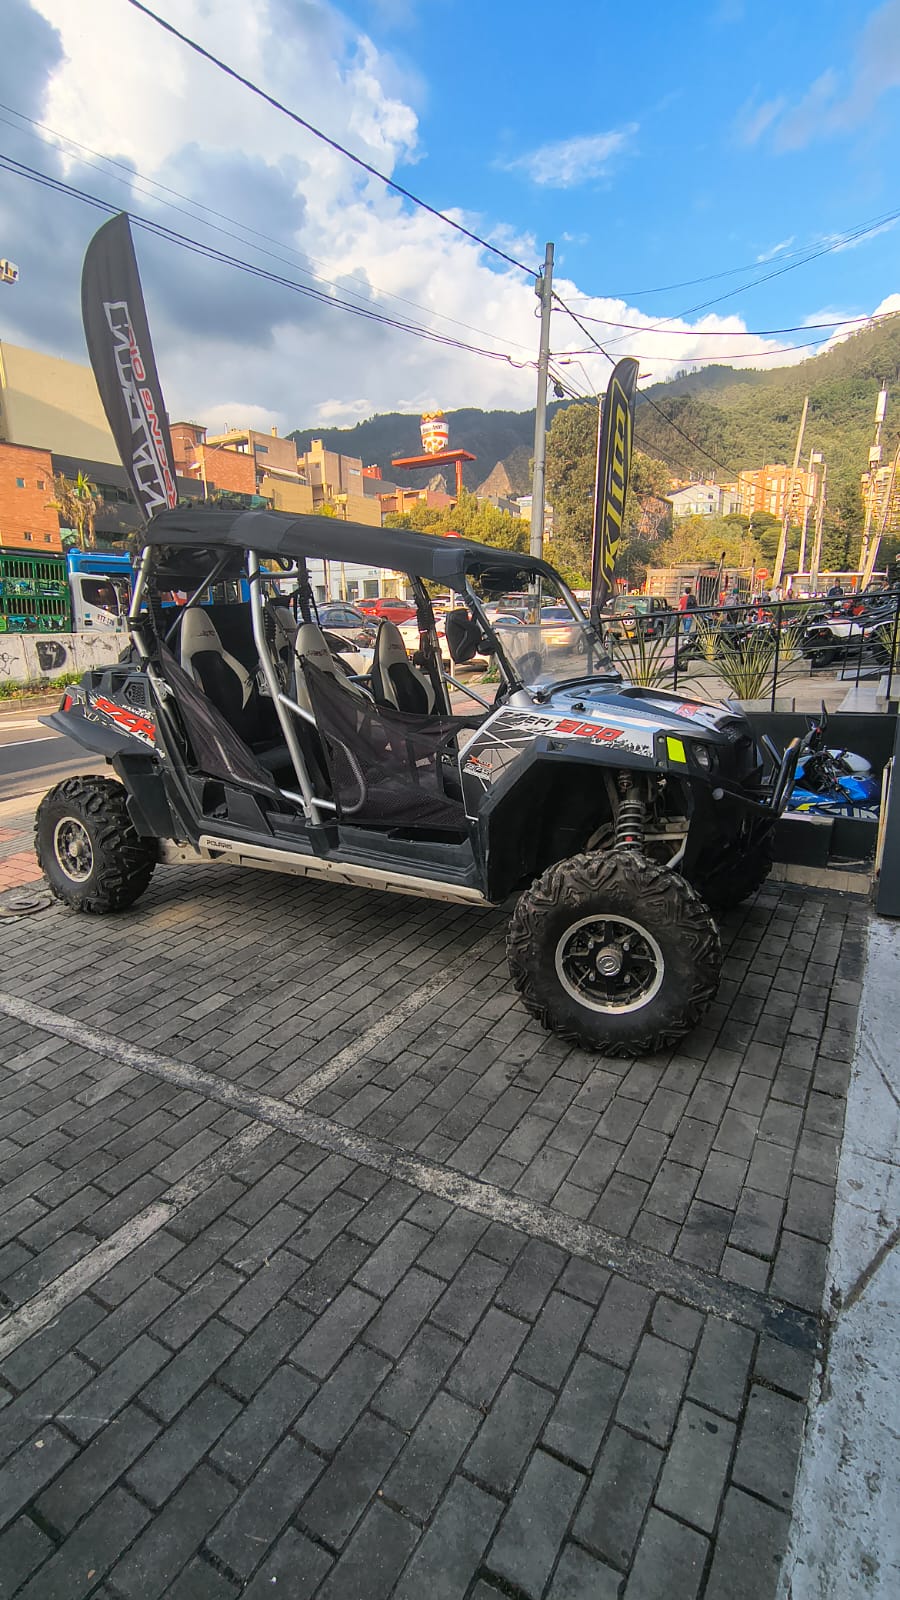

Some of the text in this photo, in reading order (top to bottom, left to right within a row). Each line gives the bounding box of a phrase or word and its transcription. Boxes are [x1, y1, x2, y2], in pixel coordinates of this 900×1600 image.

[524, 715, 625, 742] EFI 900
[206, 839, 233, 850] POLARIS
